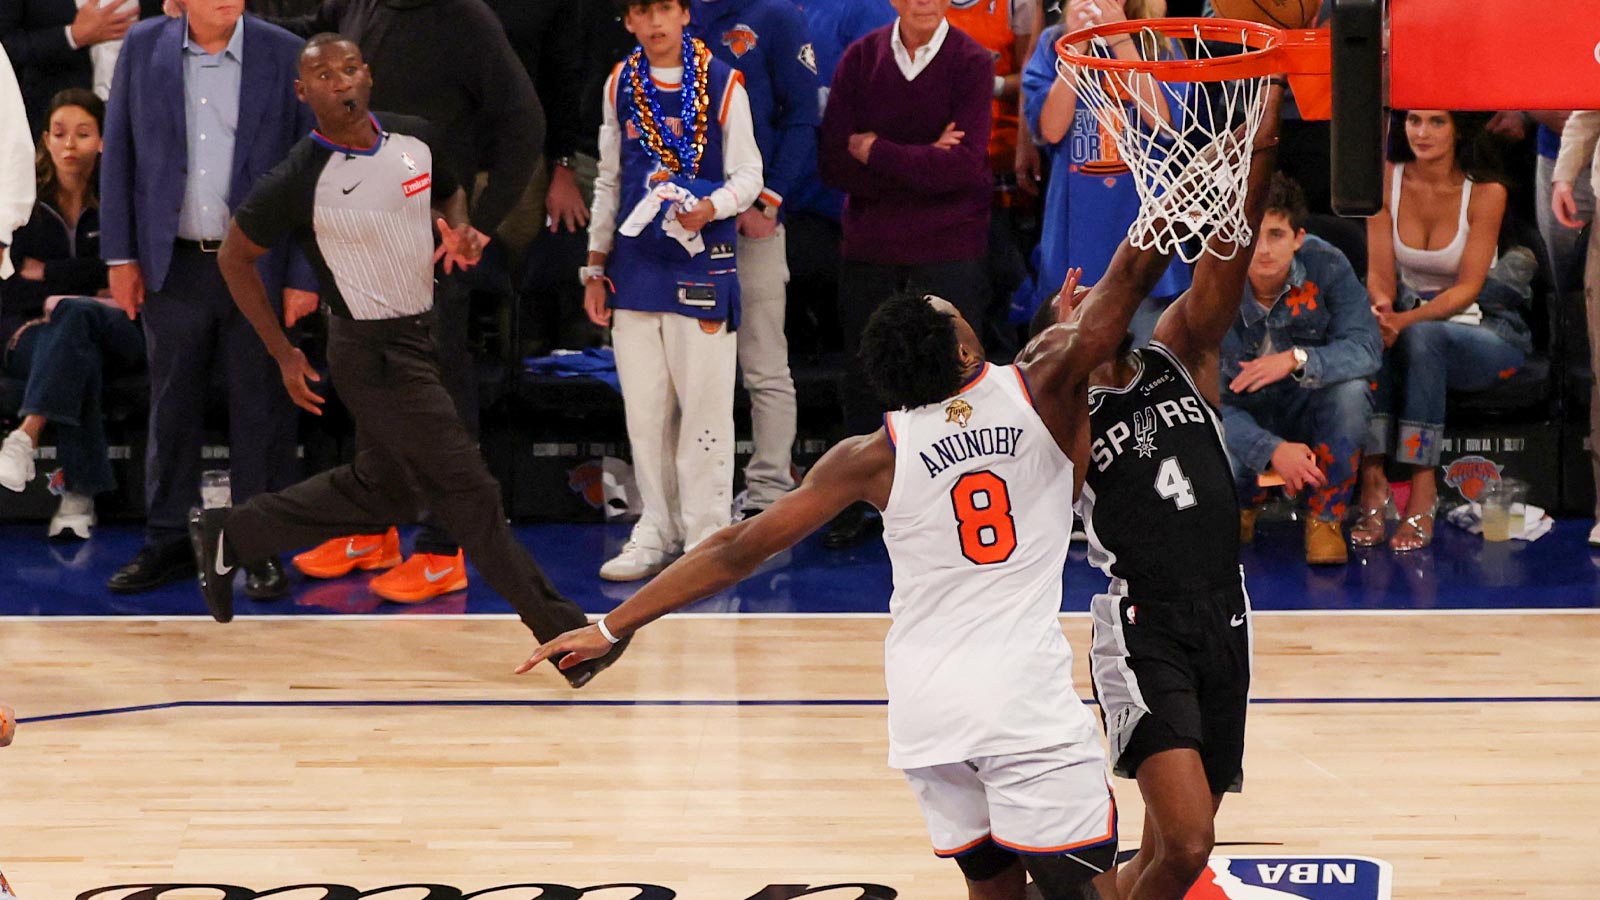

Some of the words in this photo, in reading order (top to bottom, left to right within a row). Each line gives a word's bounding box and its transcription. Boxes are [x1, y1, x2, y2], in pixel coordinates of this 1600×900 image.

[1143, 374, 1171, 392] LEDGER
[919, 426, 1024, 479] ANUNOBY
[1091, 395, 1206, 473] SPURS
[1154, 455, 1199, 512] 4
[950, 469, 1018, 565] 8
[1256, 863, 1356, 884] NBA
